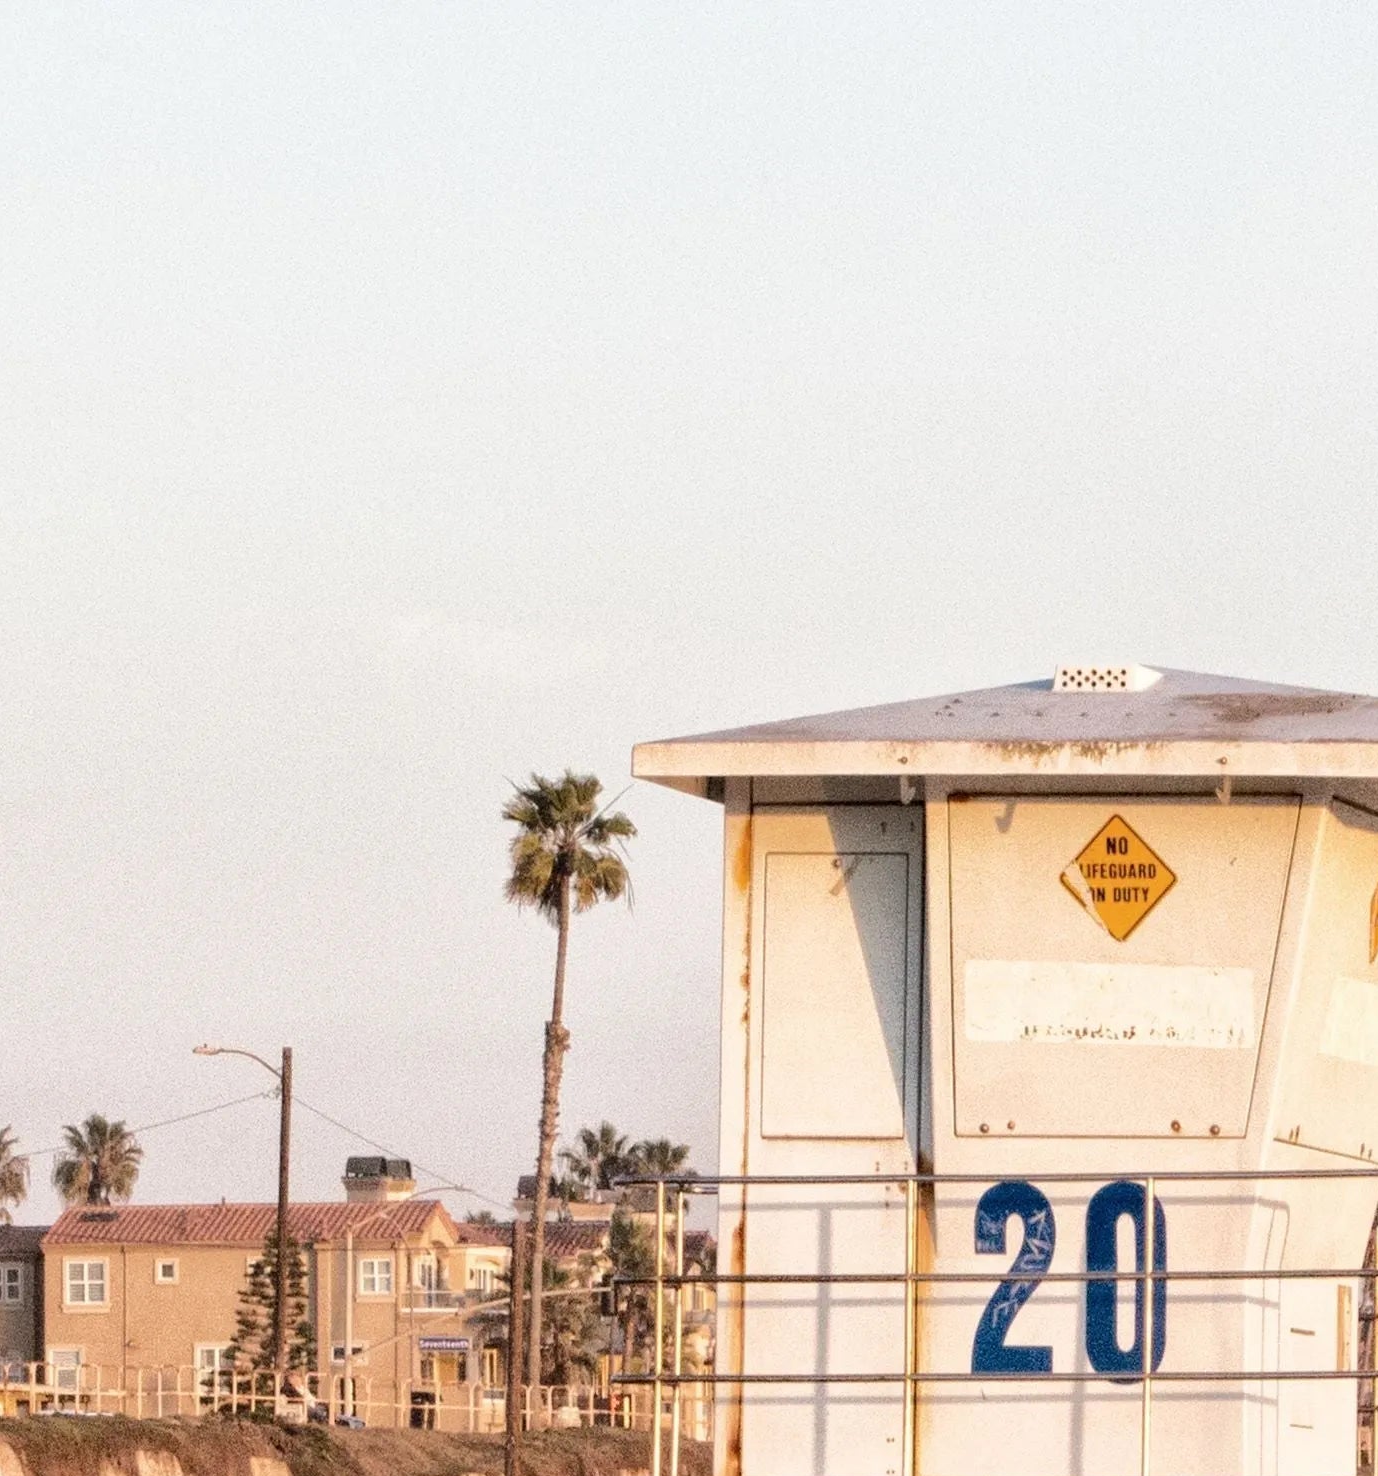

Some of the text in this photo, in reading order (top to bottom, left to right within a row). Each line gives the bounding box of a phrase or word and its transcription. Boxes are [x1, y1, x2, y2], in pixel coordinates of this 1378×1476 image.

[1106, 837, 1128, 855] NO
[1113, 887, 1150, 902] DUTY
[972, 1179, 1167, 1385] 20
